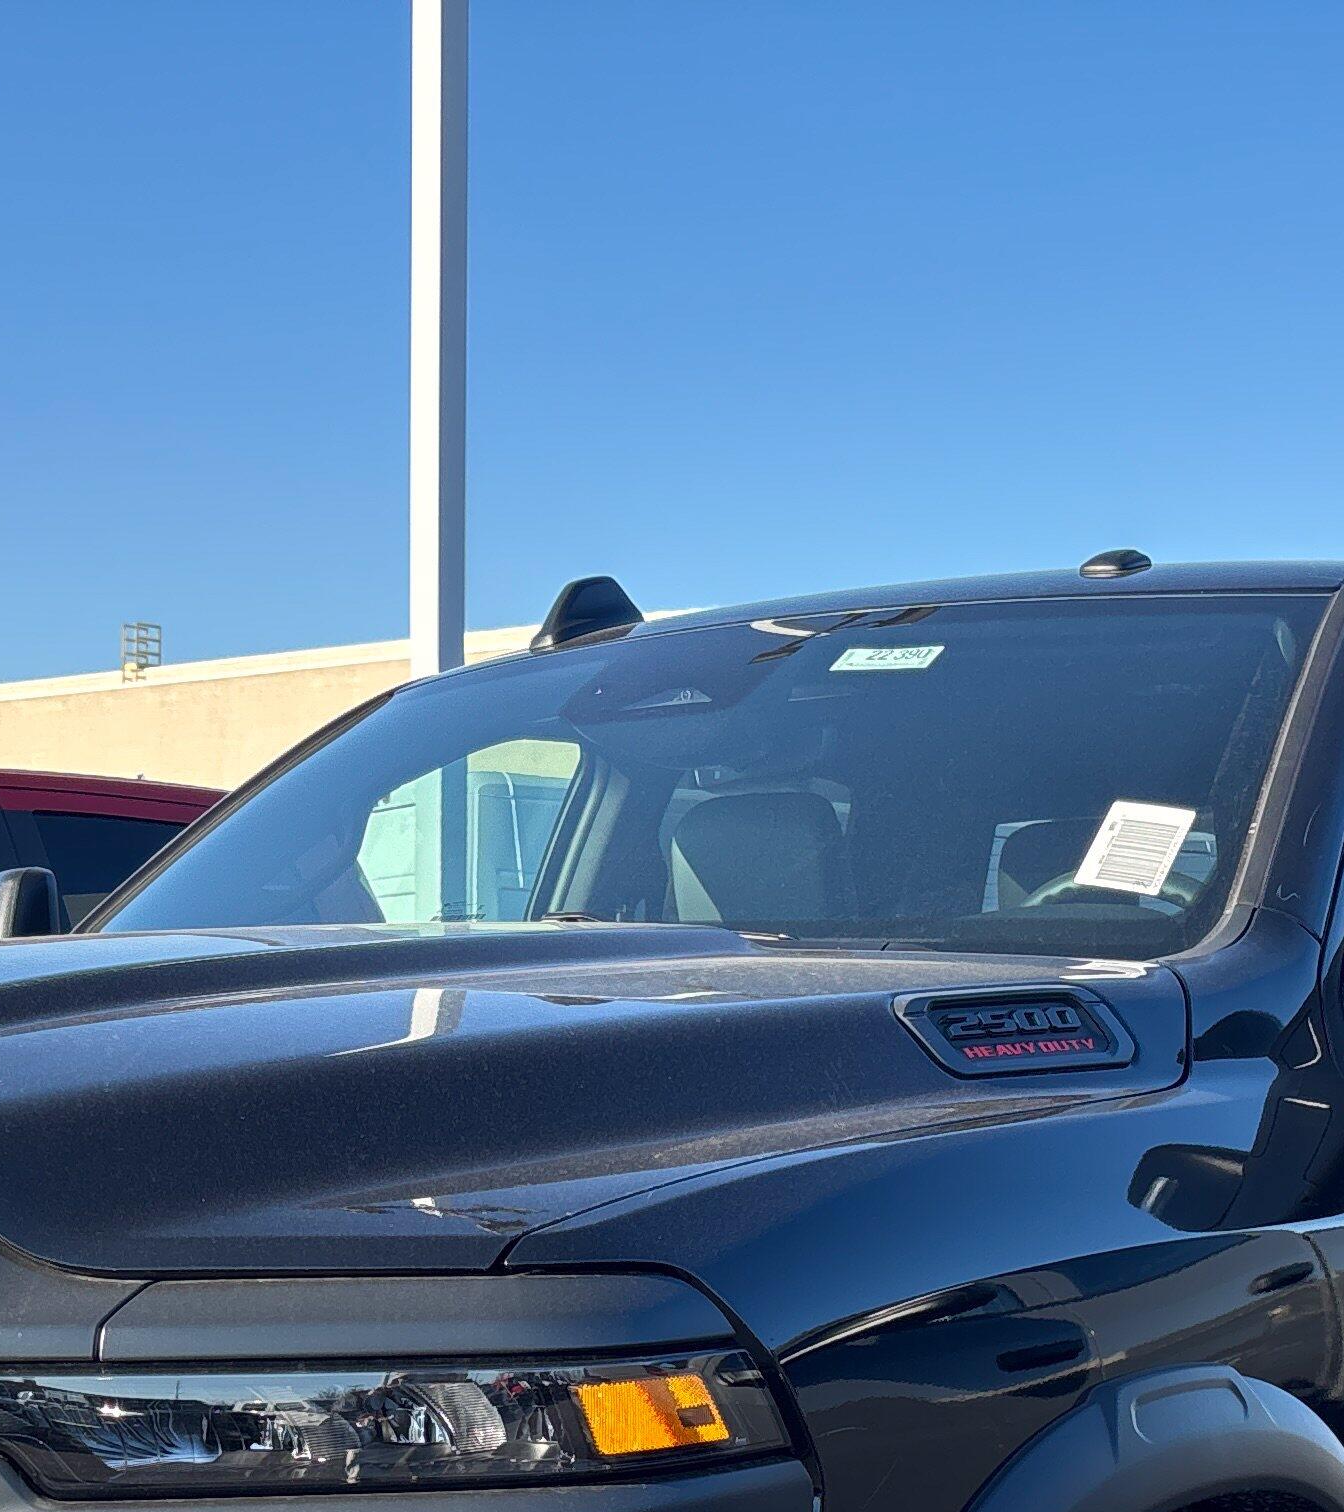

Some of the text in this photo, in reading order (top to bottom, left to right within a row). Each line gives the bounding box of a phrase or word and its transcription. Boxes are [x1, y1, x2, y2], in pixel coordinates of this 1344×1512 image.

[939, 1006, 1083, 1041] 2500
[962, 1037, 1095, 1060] HEAVY DUTY
